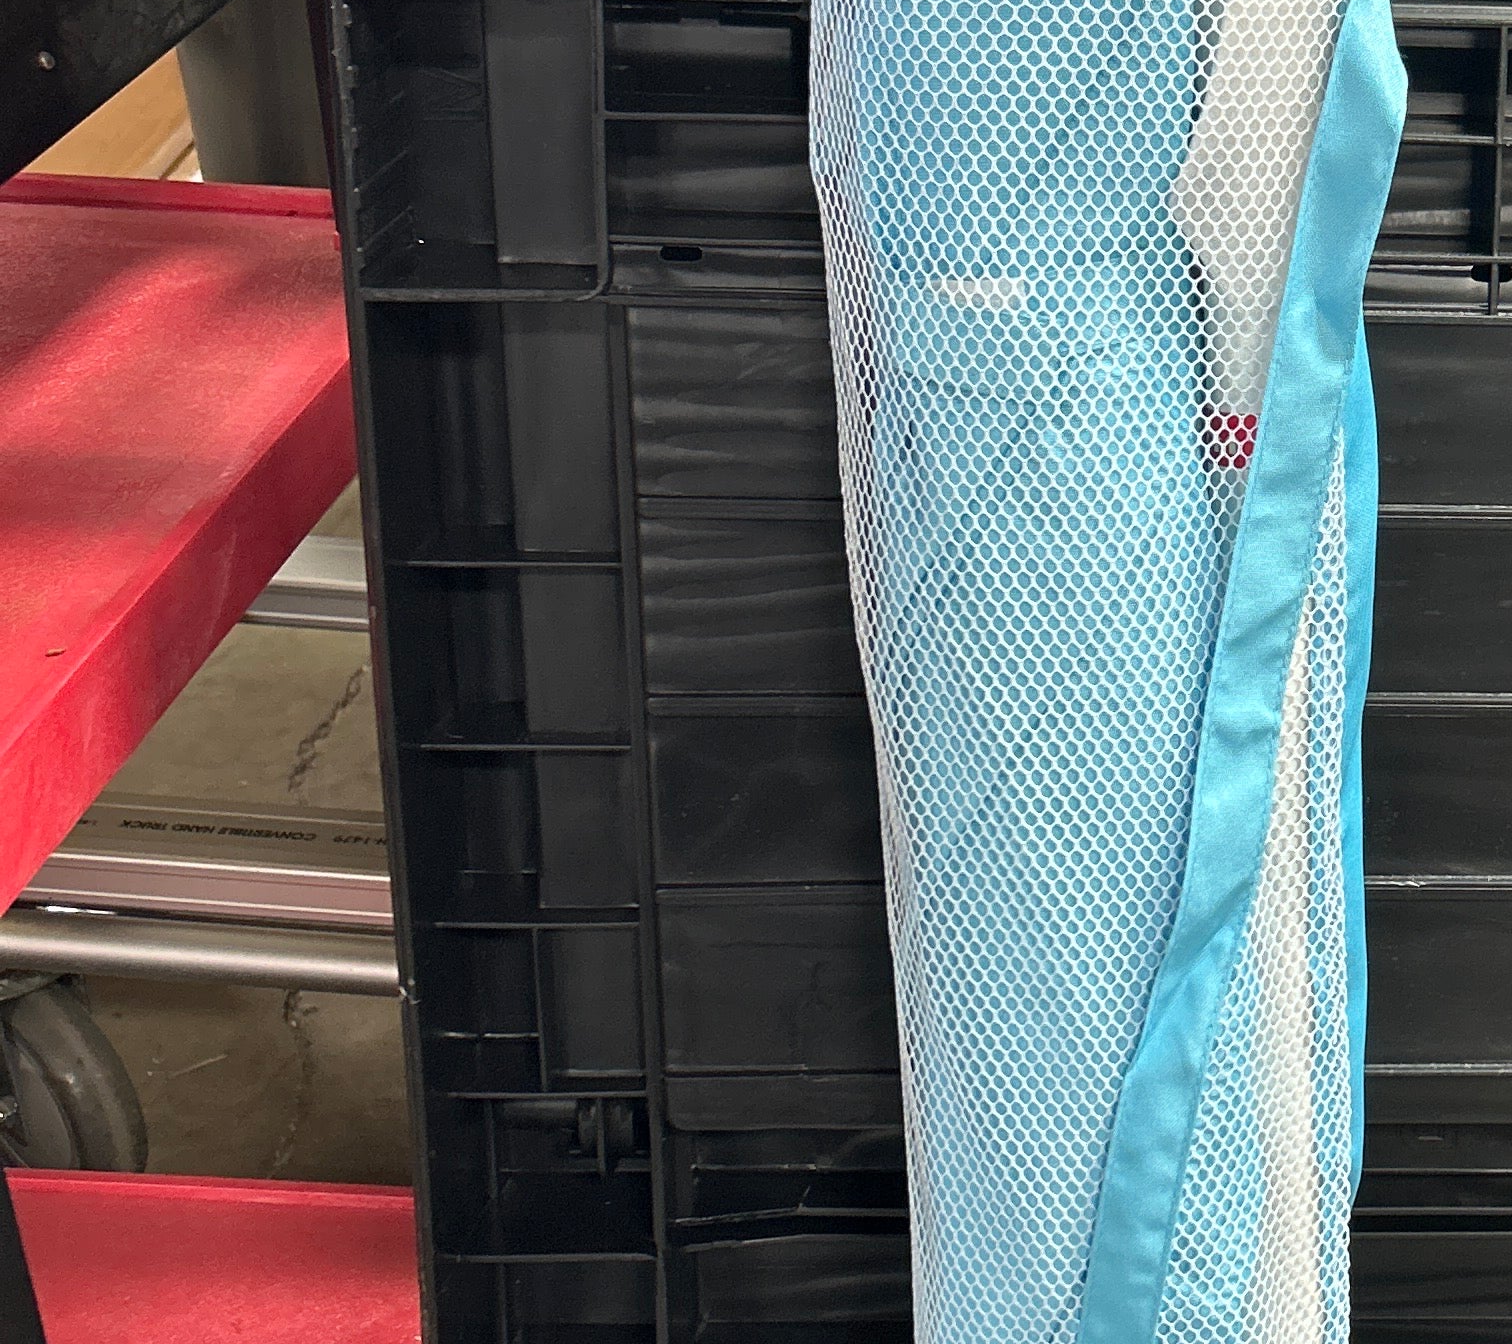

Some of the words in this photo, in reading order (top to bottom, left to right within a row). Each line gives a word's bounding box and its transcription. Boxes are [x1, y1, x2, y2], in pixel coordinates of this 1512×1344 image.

[120, 818, 168, 831] TRUCK
[172, 823, 216, 835] HAND
[218, 826, 317, 842] CONVERTIBLE
